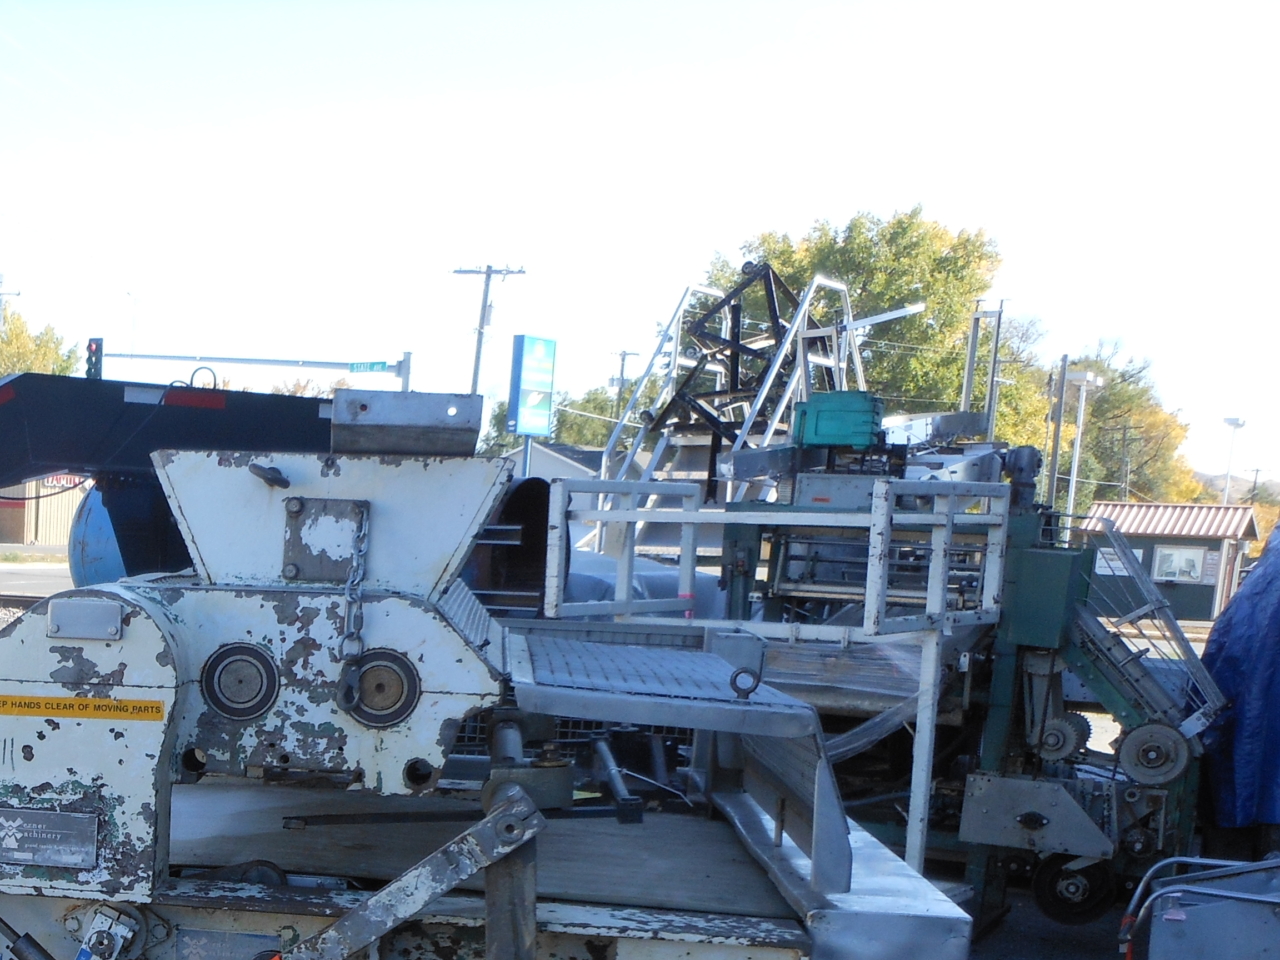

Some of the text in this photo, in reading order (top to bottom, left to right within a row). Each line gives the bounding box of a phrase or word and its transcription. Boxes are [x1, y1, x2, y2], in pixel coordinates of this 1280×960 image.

[11, 701, 41, 710] HANDS
[44, 702, 75, 711] CLEAR
[78, 703, 90, 712] OF
[93, 704, 129, 713] MOVING
[132, 705, 161, 714] PARTS
